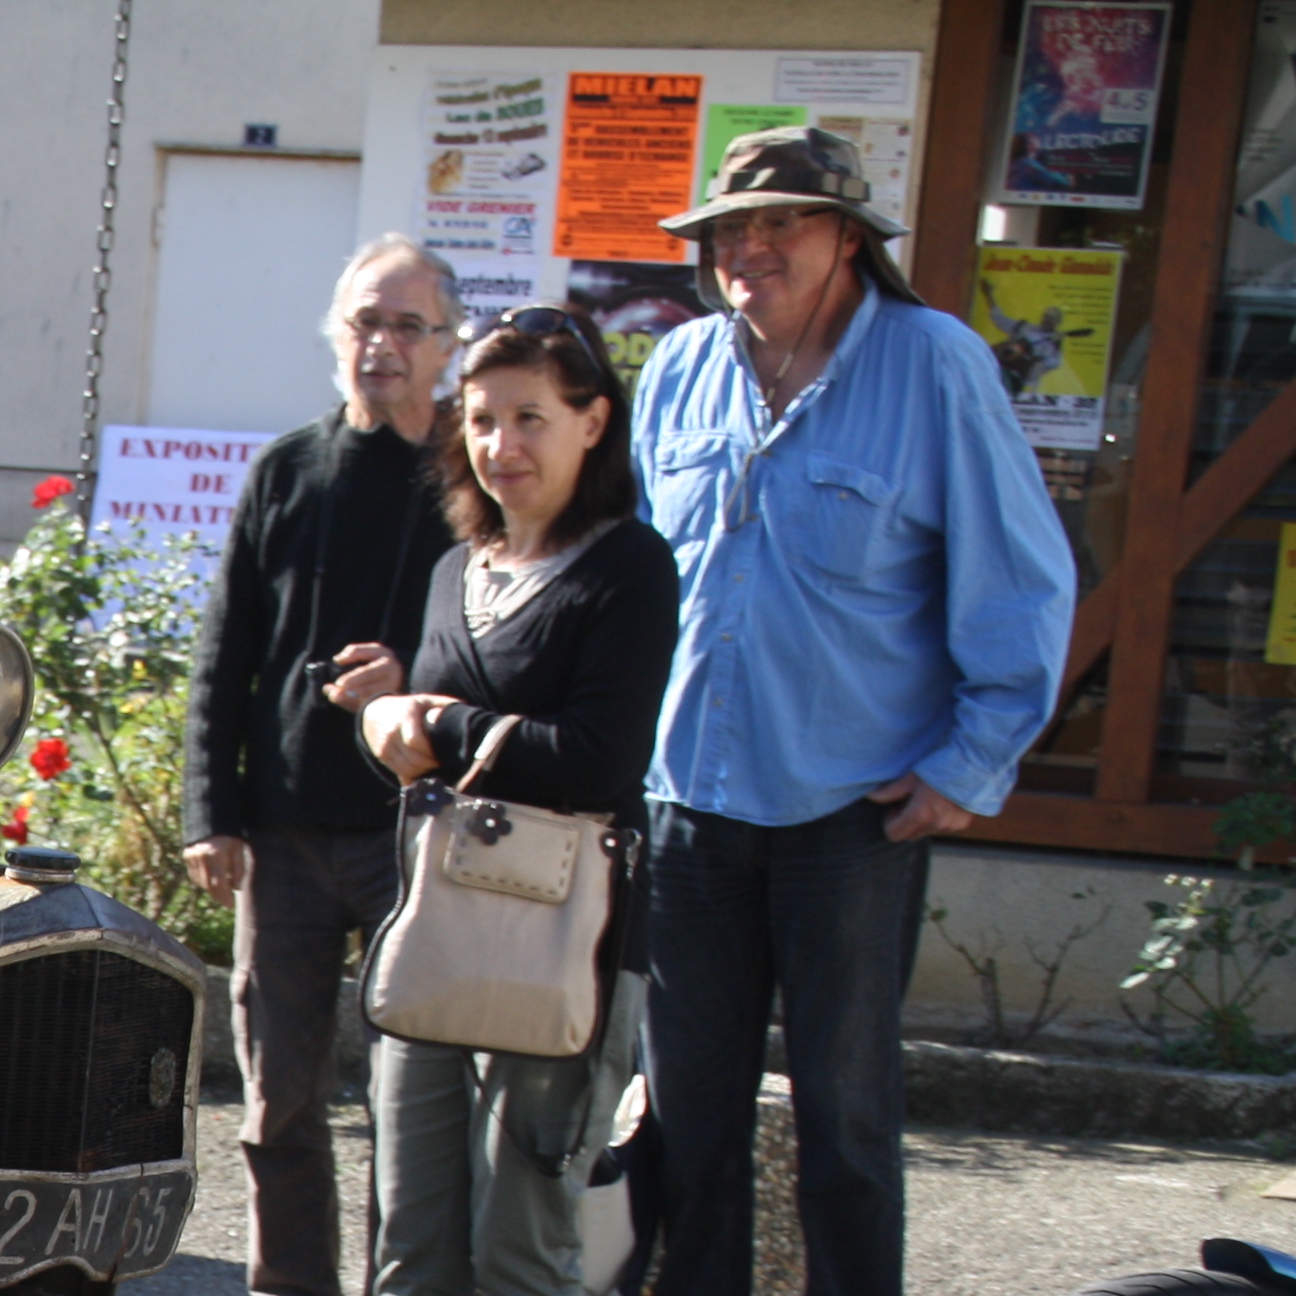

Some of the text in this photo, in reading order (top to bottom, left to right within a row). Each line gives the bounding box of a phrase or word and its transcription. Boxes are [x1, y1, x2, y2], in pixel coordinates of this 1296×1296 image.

[573, 77, 697, 98] MIELAN
[1133, 92, 1149, 112] 5
[427, 201, 462, 213] VIDE
[457, 271, 532, 298] eptembre
[1010, 394, 1058, 407] LAN
[119, 436, 263, 463] EXPOSIT
[188, 472, 231, 494] DE
[44, 1187, 115, 1257] AH
[119, 1186, 173, 1259] 65
